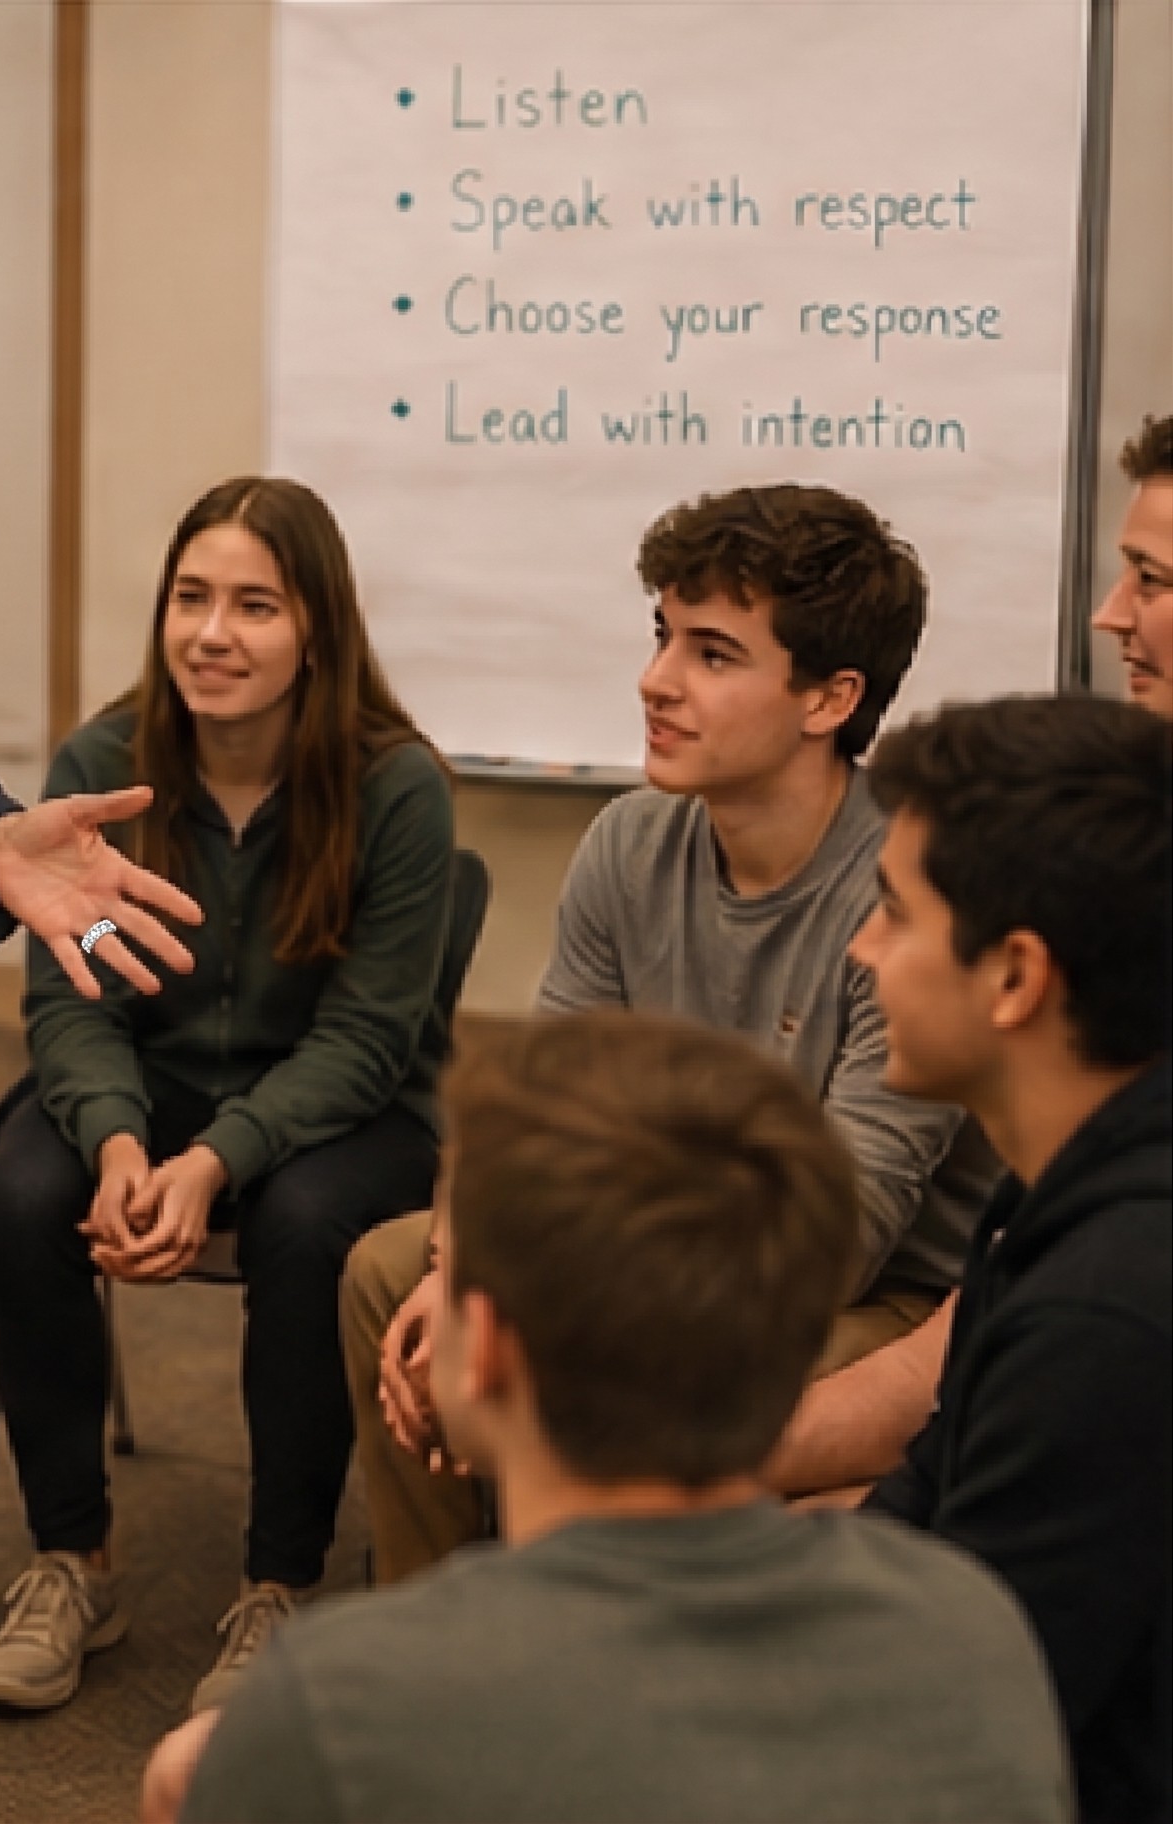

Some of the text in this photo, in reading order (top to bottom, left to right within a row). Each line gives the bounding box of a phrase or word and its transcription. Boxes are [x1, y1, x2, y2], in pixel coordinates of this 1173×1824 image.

[451, 65, 648, 129] Listen
[451, 167, 978, 251] Speak with respect
[443, 275, 1003, 363] Choose your response
[444, 379, 966, 453] Lead with intention
